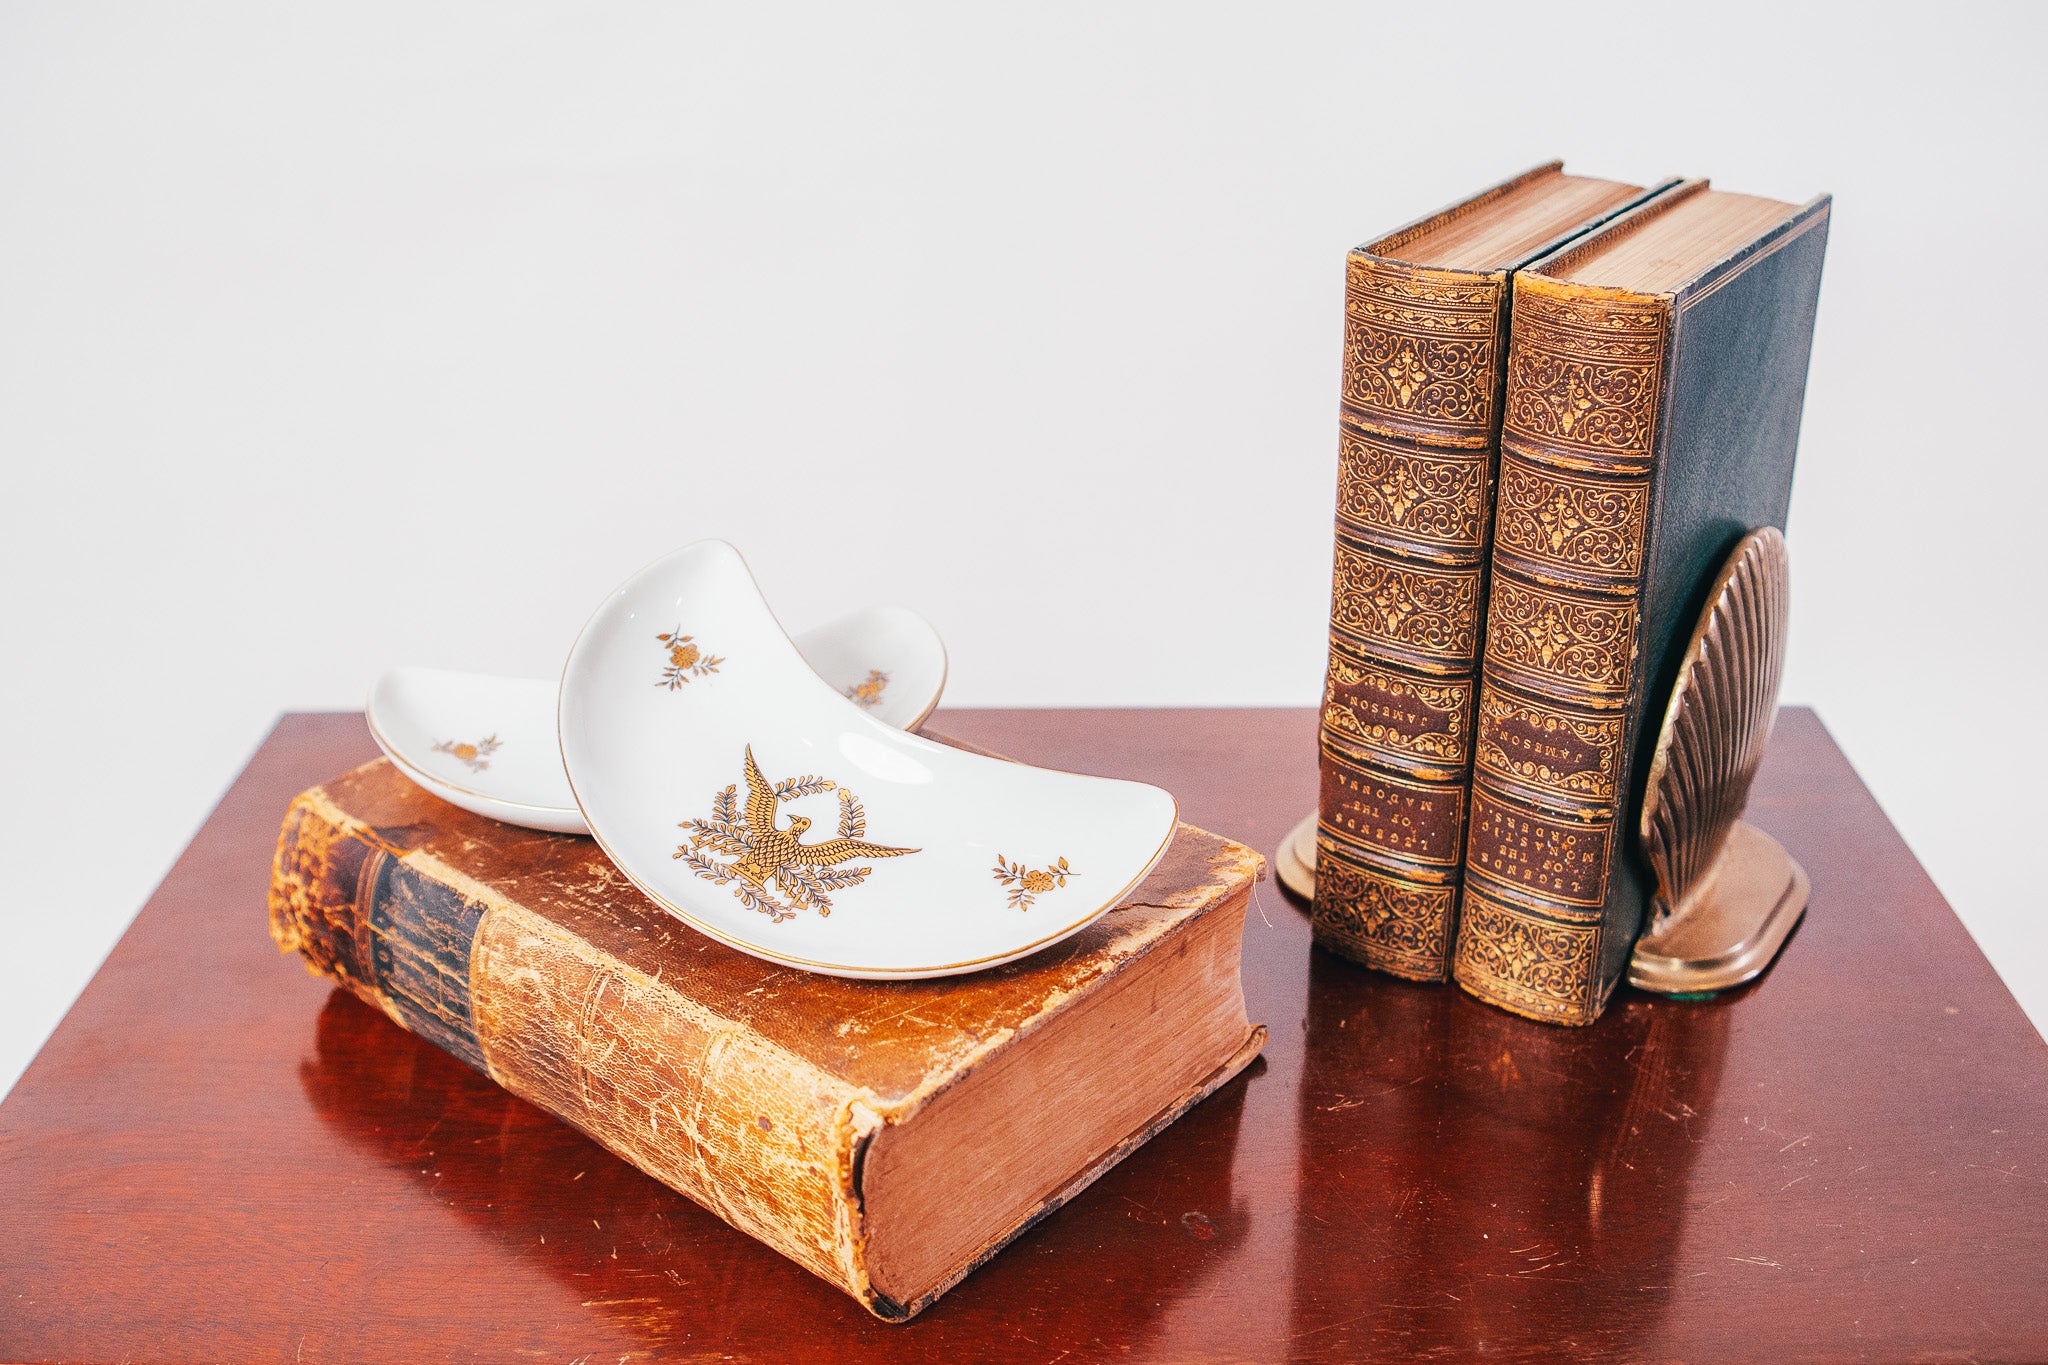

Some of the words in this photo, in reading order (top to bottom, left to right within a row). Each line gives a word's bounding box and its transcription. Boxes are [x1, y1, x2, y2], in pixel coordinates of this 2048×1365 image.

[1353, 801, 1379, 818] THE
[1391, 813, 1411, 827] OF
[1335, 813, 1428, 850] LEGENDS
[1481, 822, 1594, 862] MONASTIC
[1499, 845, 1527, 863] THE
[1481, 853, 1580, 892] LEGENDS
[1542, 860, 1563, 873] OF
